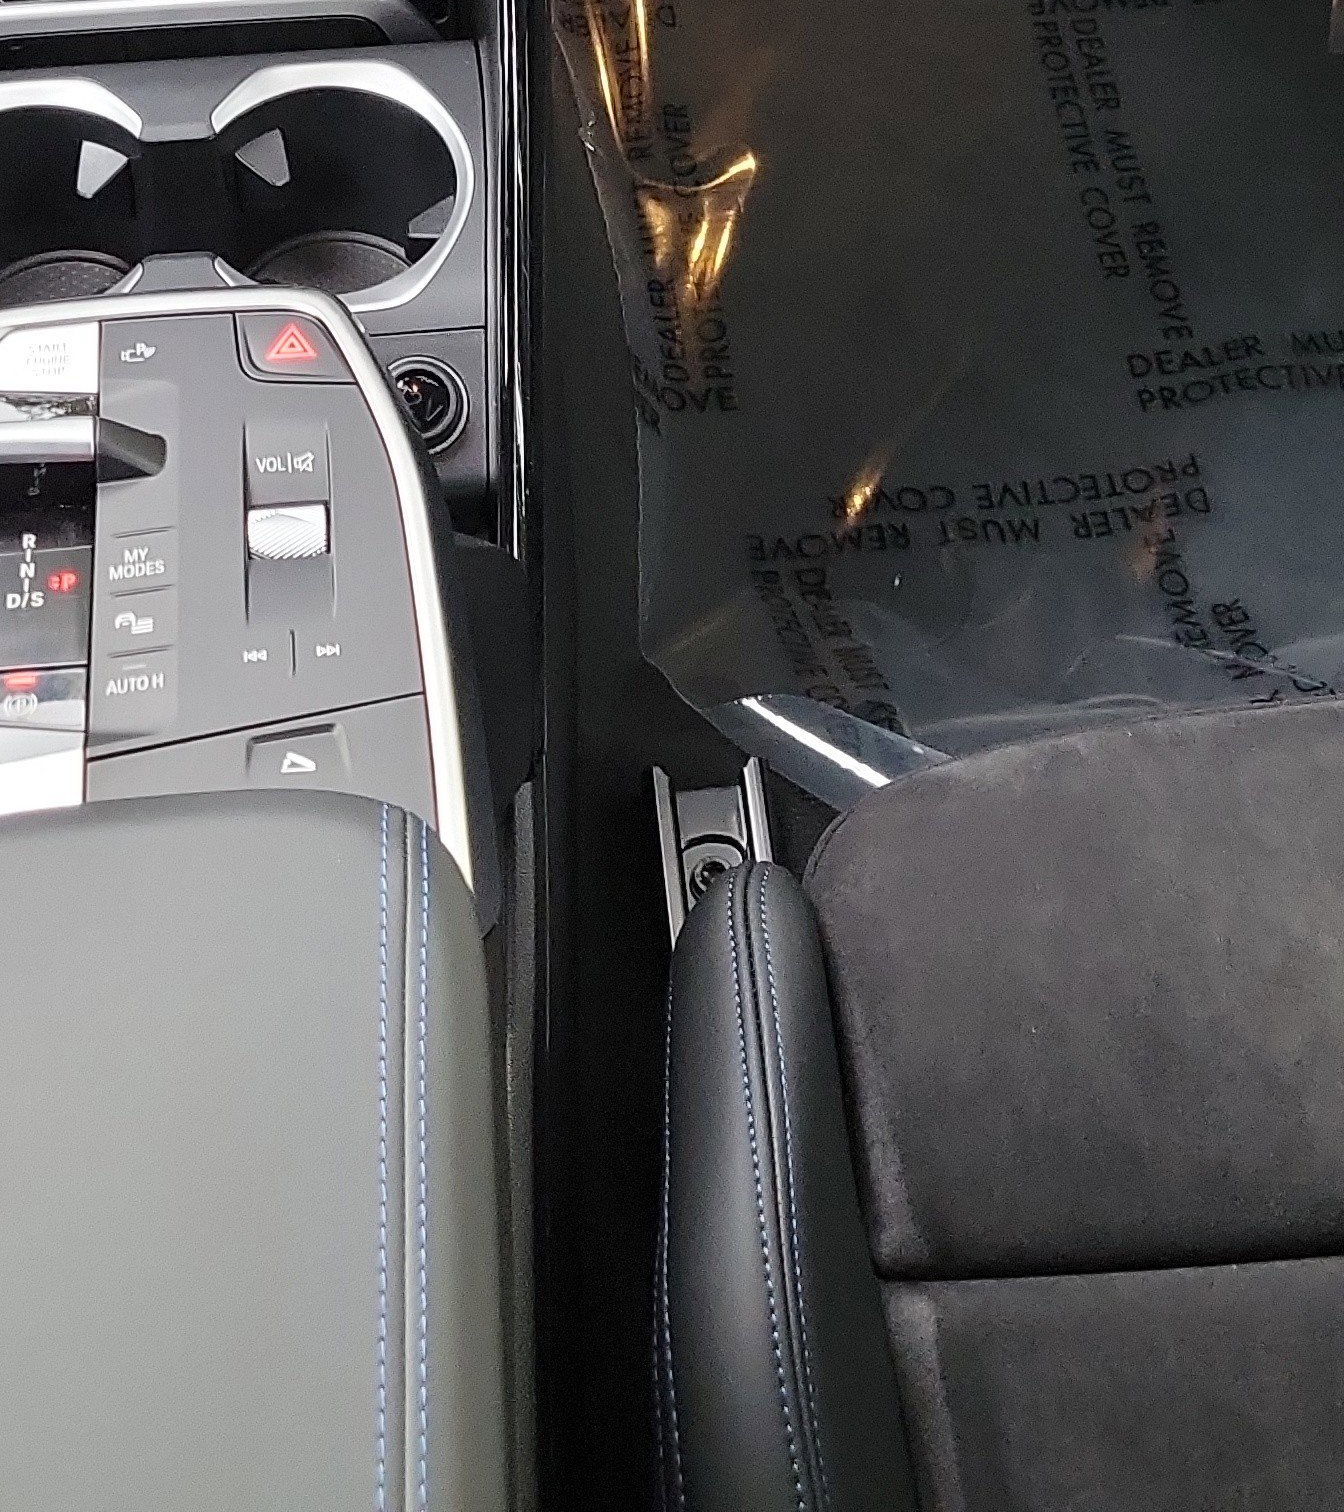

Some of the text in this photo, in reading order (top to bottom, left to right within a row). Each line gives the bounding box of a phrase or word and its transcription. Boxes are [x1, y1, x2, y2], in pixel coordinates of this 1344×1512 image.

[1033, 19, 1131, 280] PROTECTIVE COVER
[1071, 17, 1194, 341] DEALER MUST REMOVE
[1126, 334, 1264, 381] DEALER
[256, 452, 286, 474] VOL
[976, 452, 1203, 508] PROTECTIVE
[747, 485, 1212, 563] DEALER MUST REMOVE
[22, 533, 37, 549] R
[123, 546, 150, 564] MY
[19, 563, 35, 580] N
[109, 559, 166, 581] MODES
[6, 591, 45, 609] D/S
[106, 672, 164, 696] AUTO H
